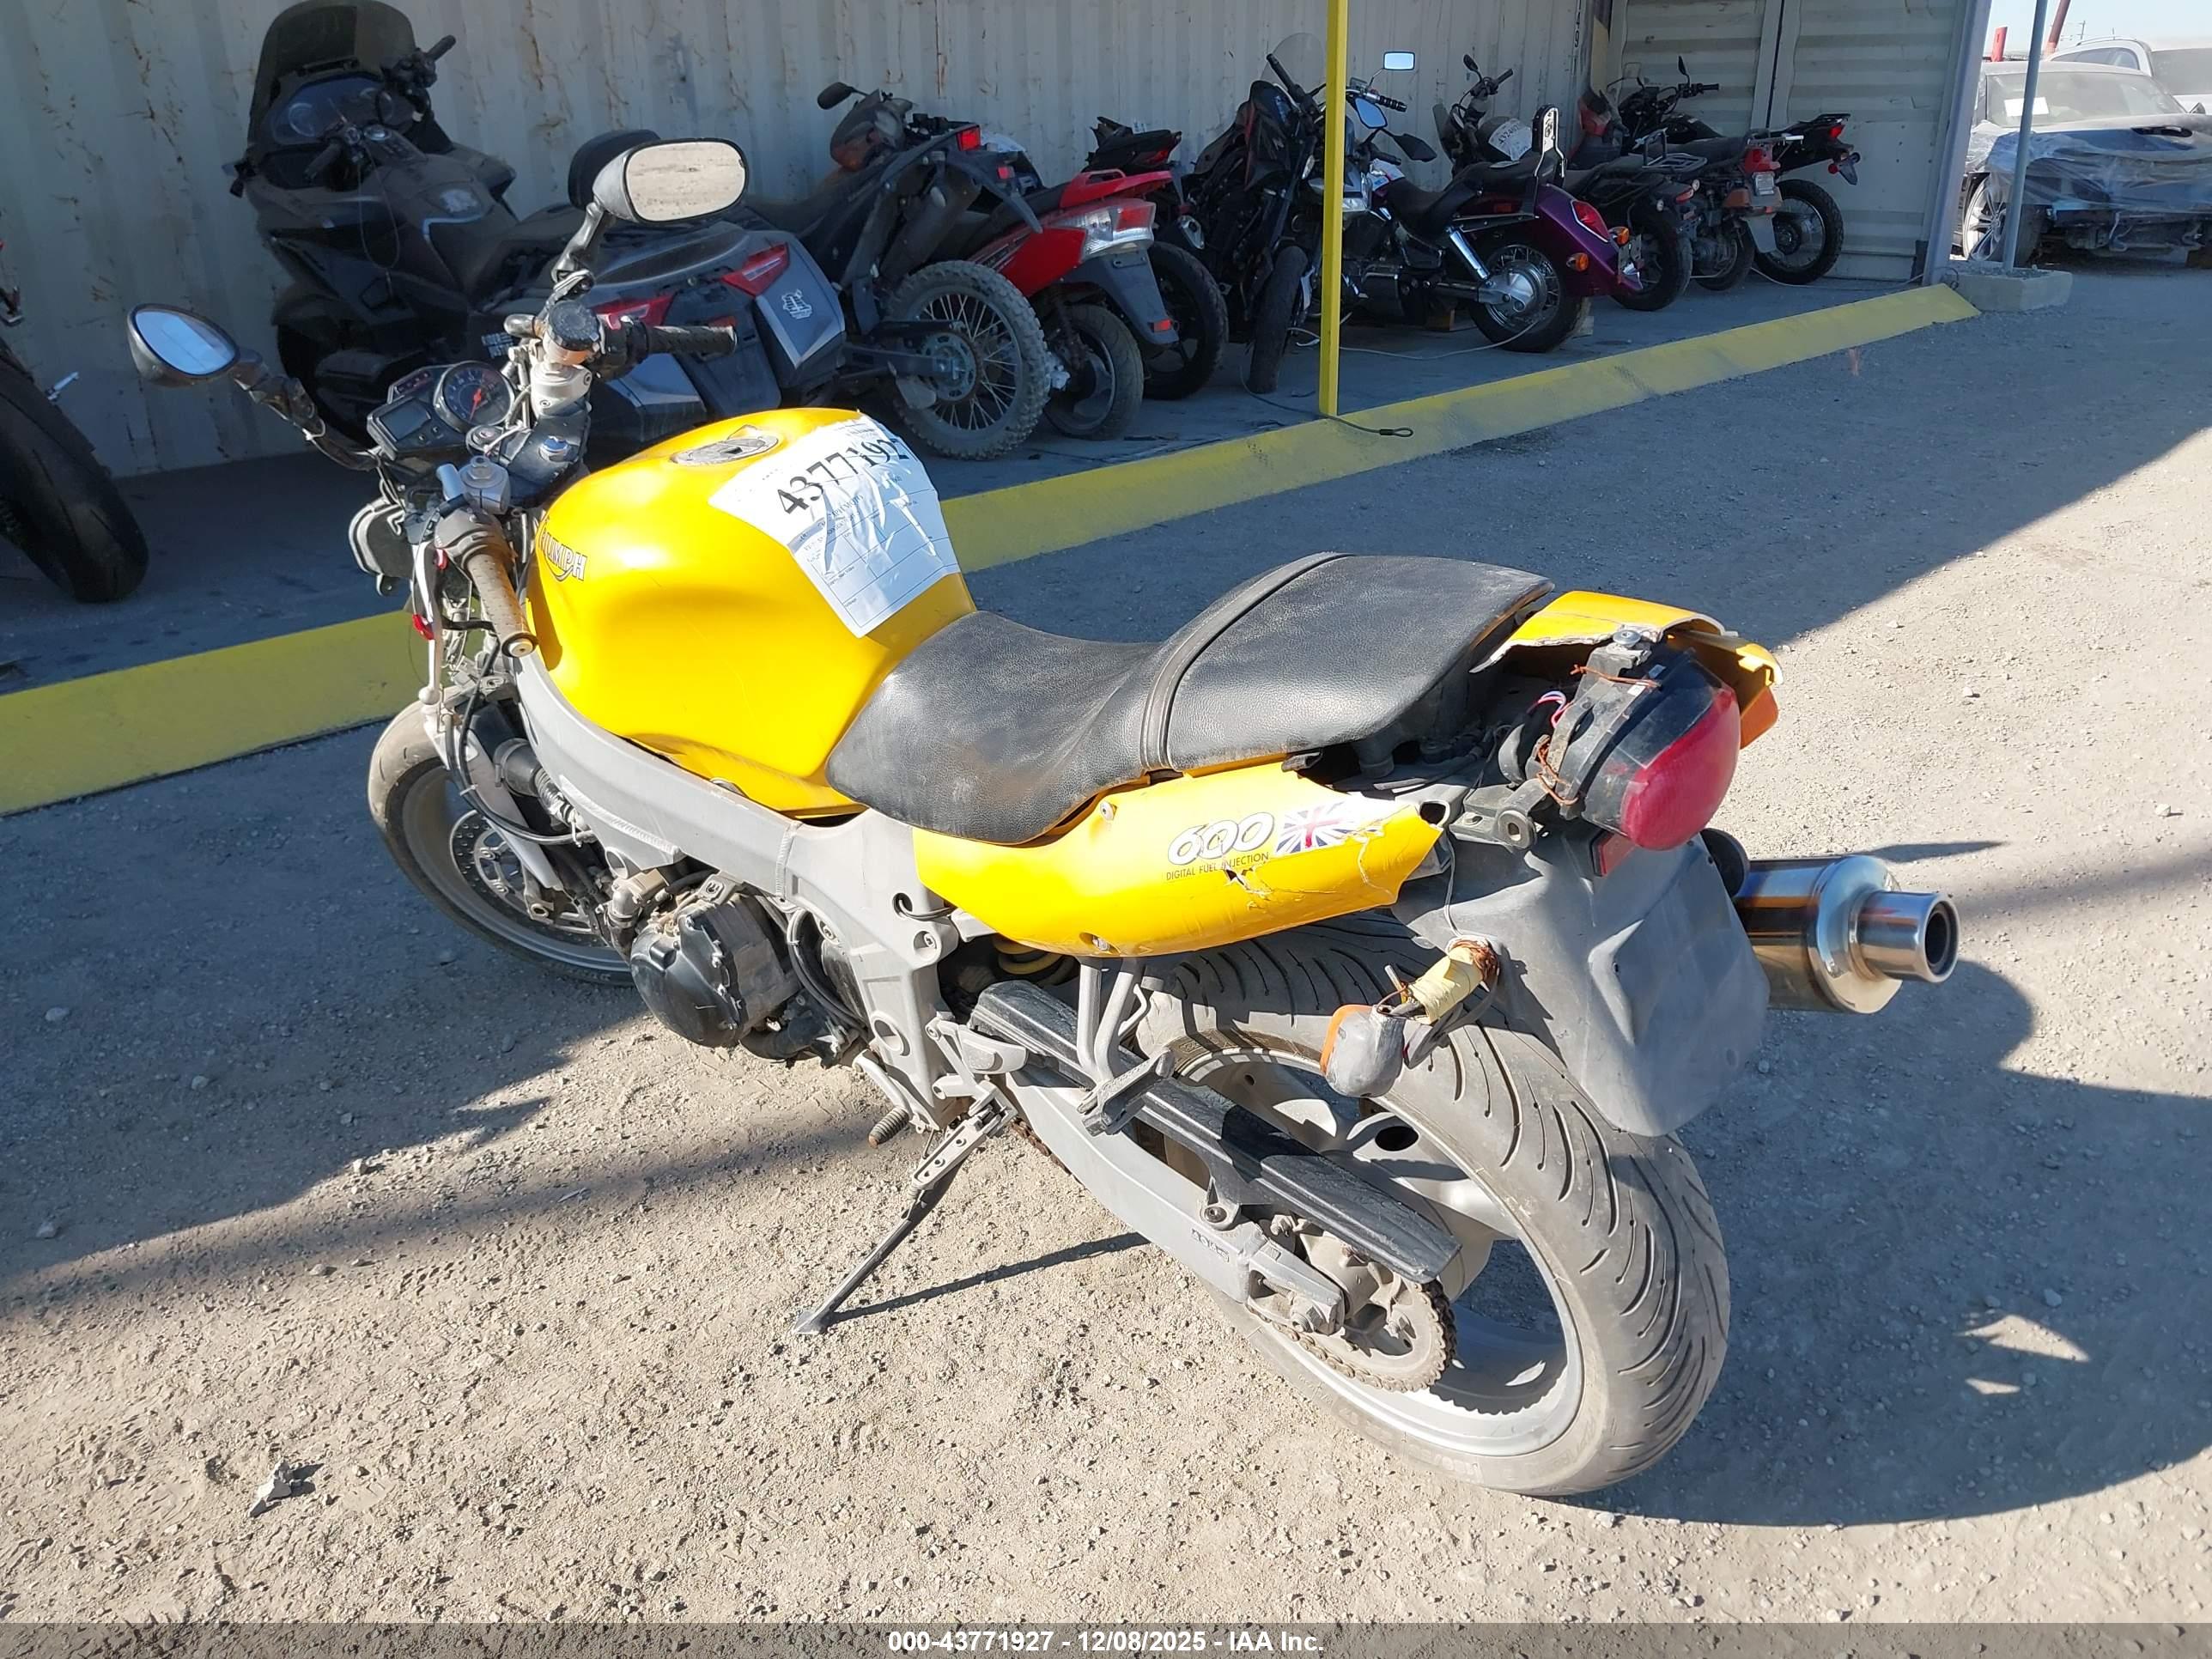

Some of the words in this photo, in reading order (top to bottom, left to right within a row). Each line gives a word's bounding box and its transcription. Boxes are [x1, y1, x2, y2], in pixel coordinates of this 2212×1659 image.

[539, 520, 589, 581] RIUMPH
[1167, 811, 1275, 866] 600
[1166, 866, 1196, 881] DIGITAL
[1199, 862, 1218, 874] FUEL
